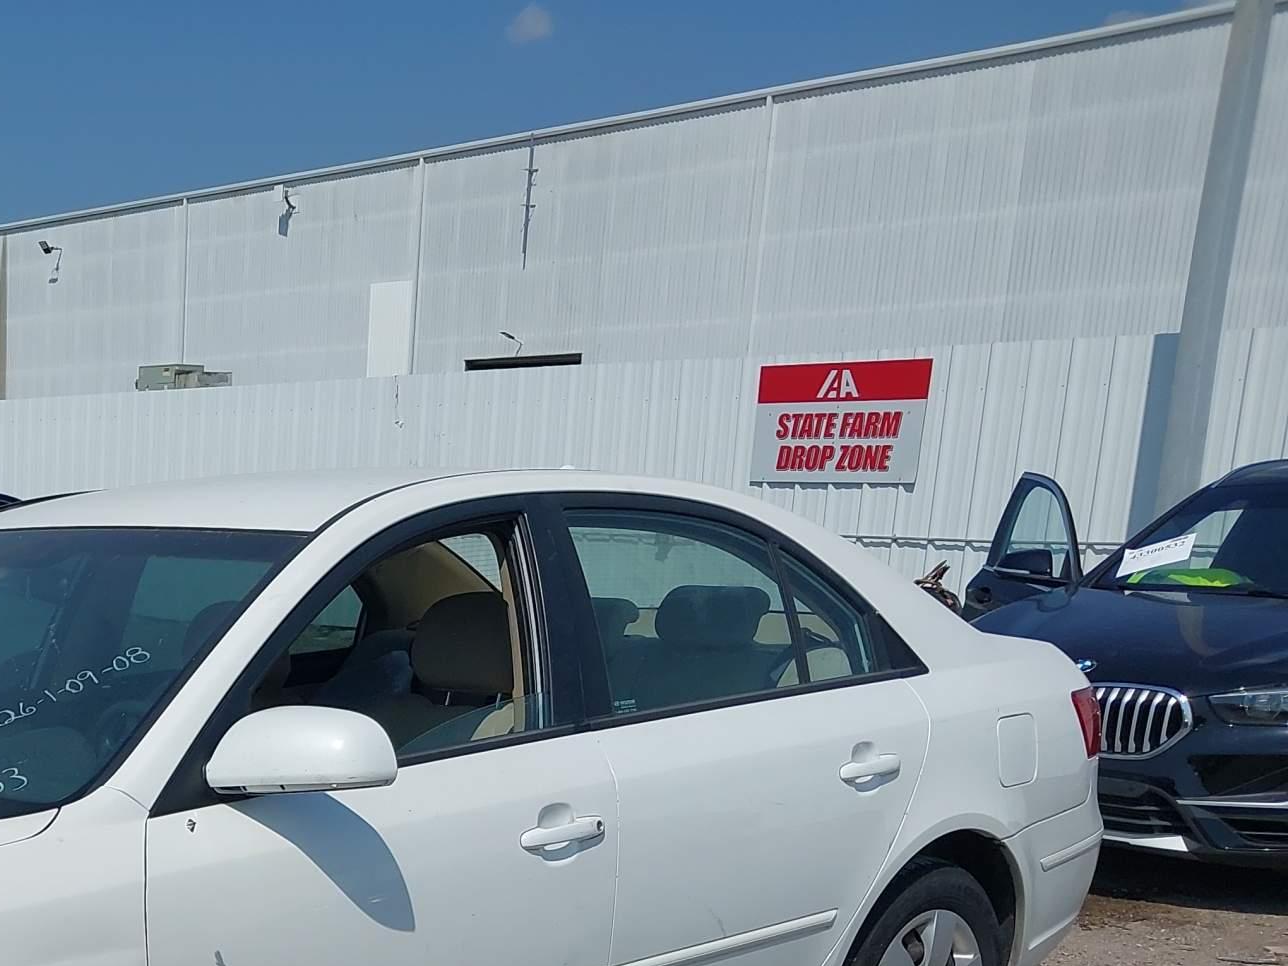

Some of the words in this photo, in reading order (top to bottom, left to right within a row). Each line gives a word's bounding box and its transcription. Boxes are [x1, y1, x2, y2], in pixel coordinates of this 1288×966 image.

[776, 412, 837, 440] STATE
[838, 410, 903, 440] FARM
[776, 445, 835, 472] DROP
[835, 443, 894, 472] ZONE
